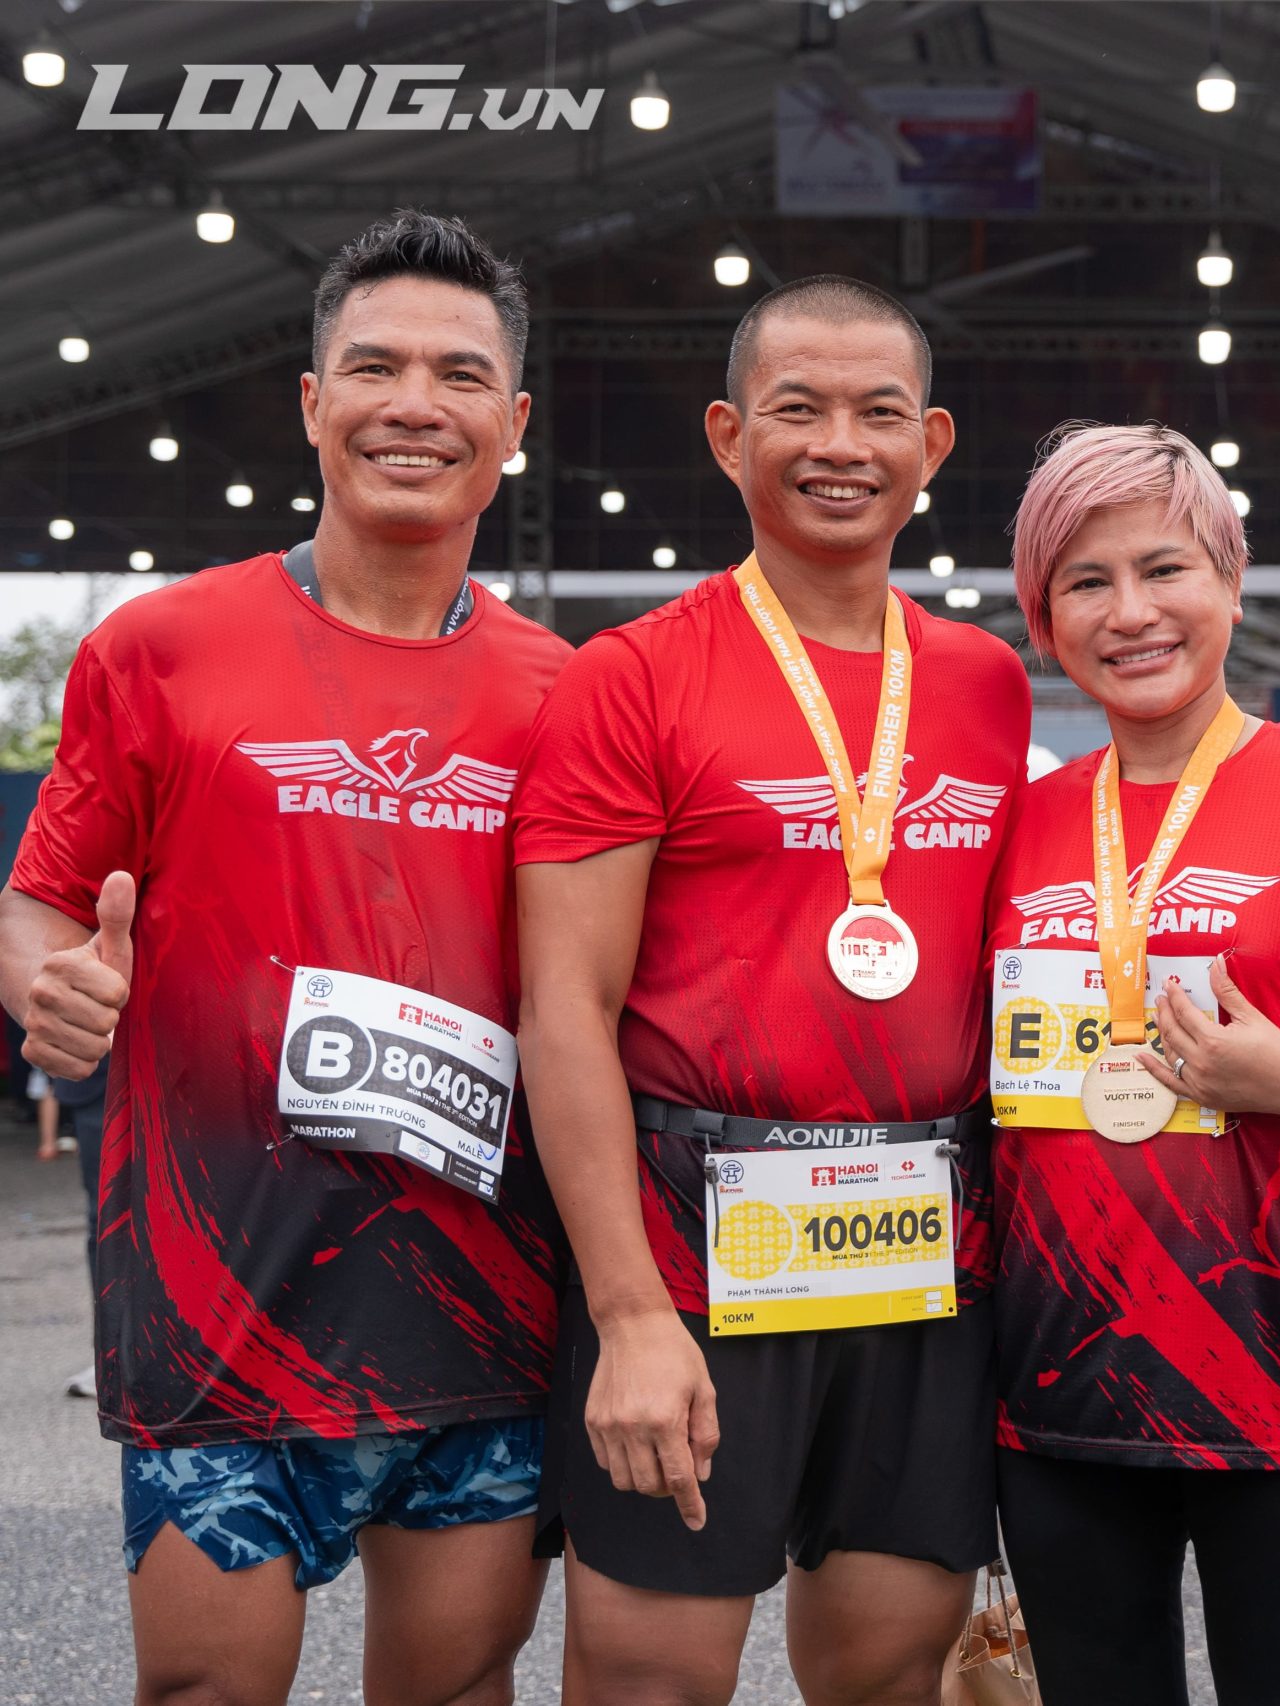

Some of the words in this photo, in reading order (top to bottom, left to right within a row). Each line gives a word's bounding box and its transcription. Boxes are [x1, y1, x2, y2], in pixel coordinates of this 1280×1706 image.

[873, 704, 902, 798] FINISHER
[889, 648, 905, 698] 10KM
[277, 785, 400, 824] EAGLE
[408, 801, 506, 834] CAMP
[783, 822, 896, 851] EAG
[904, 823, 991, 850] CAMP
[1131, 838, 1177, 927] FINISHER
[1167, 785, 1201, 833] 10KM
[1020, 916, 1099, 944] EAG
[423, 1022, 461, 1041] MARATHON
[424, 1010, 462, 1033] HANOI
[1009, 1013, 1042, 1059] E
[305, 1030, 354, 1079] B
[382, 1046, 503, 1130] 804031
[1033, 1080, 1061, 1091] Thoa
[997, 1106, 1017, 1116] 10KM
[290, 1124, 357, 1139] MARATHON
[1112, 1120, 1146, 1128] FINISHER
[763, 1126, 888, 1147] AONIJIE
[457, 1140, 483, 1160] MALE
[838, 1163, 879, 1176] HANOI
[838, 1177, 879, 1185] MARATHON
[804, 1207, 942, 1252] 100406
[785, 1286, 810, 1294] LONG
[722, 1312, 754, 1324] 10KM
